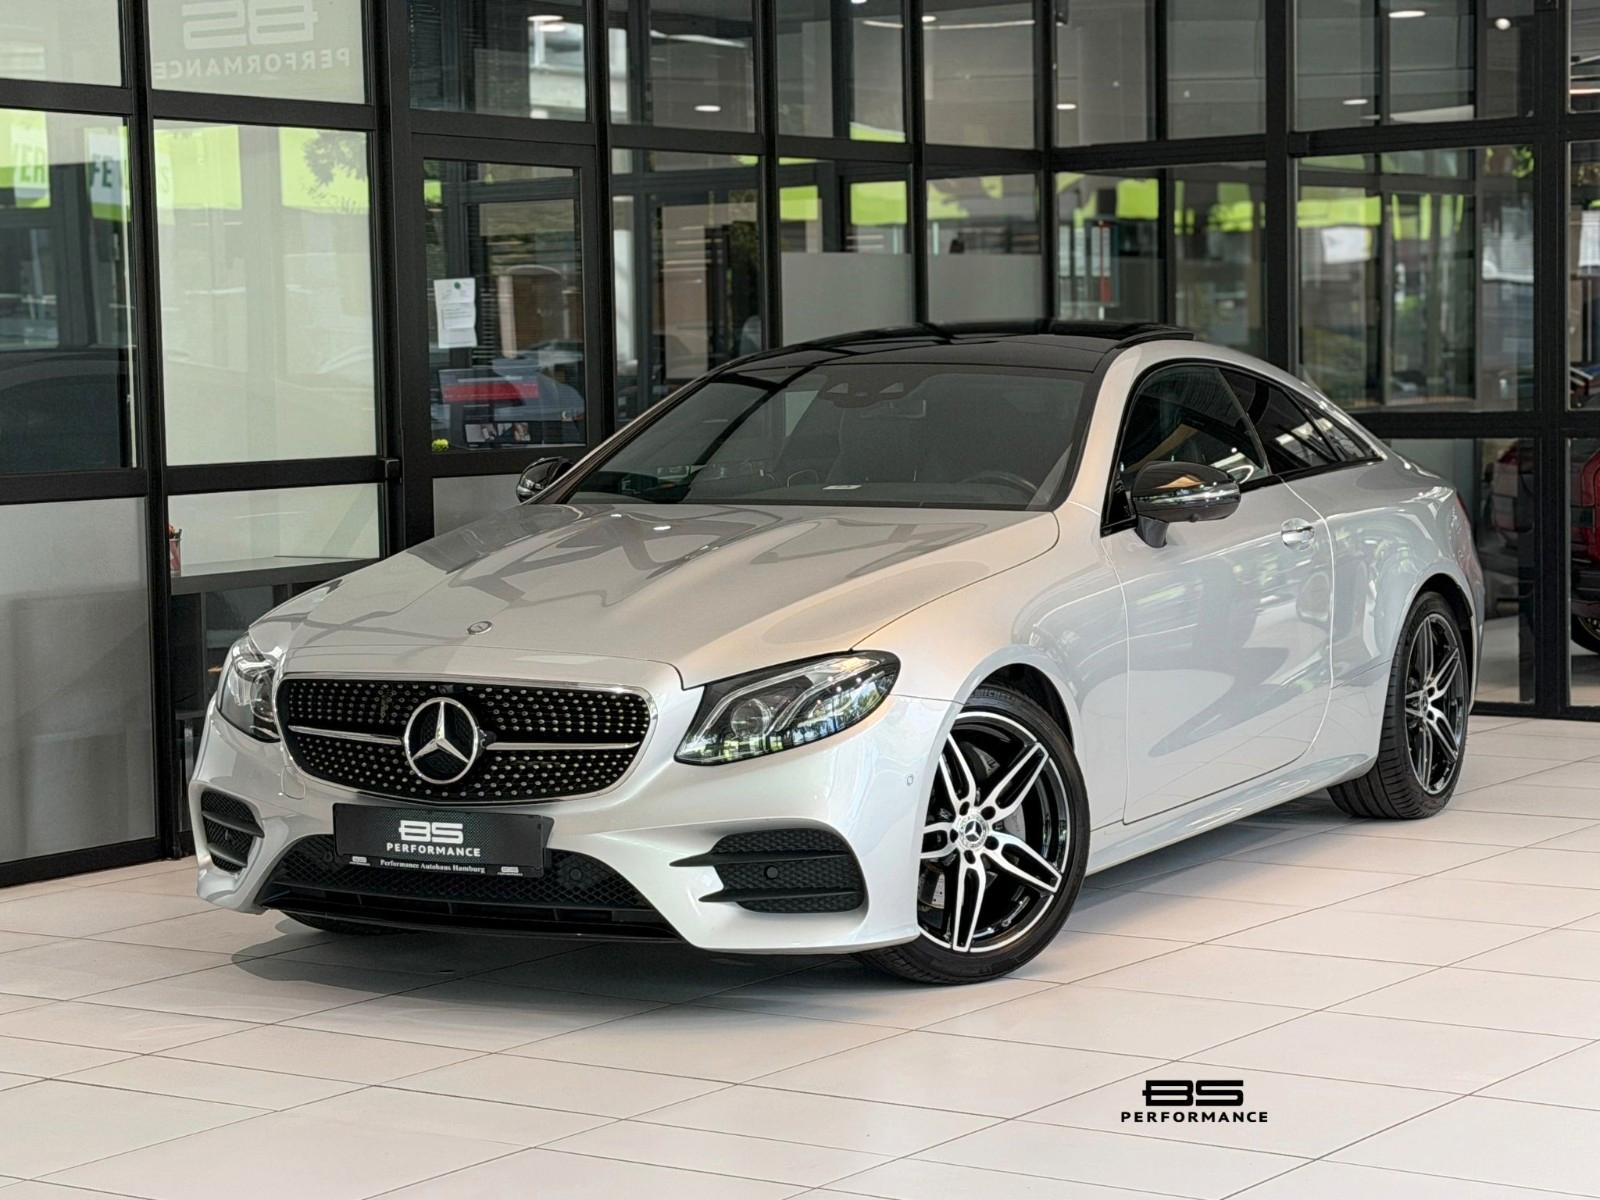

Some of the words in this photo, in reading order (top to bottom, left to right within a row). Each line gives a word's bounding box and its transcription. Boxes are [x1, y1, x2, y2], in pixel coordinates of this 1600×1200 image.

[398, 819, 464, 844] BS
[386, 842, 481, 857] PERFORMANCE
[380, 858, 419, 869] Performance
[420, 862, 451, 871] Autohaus
[452, 864, 485, 875] Hamburg
